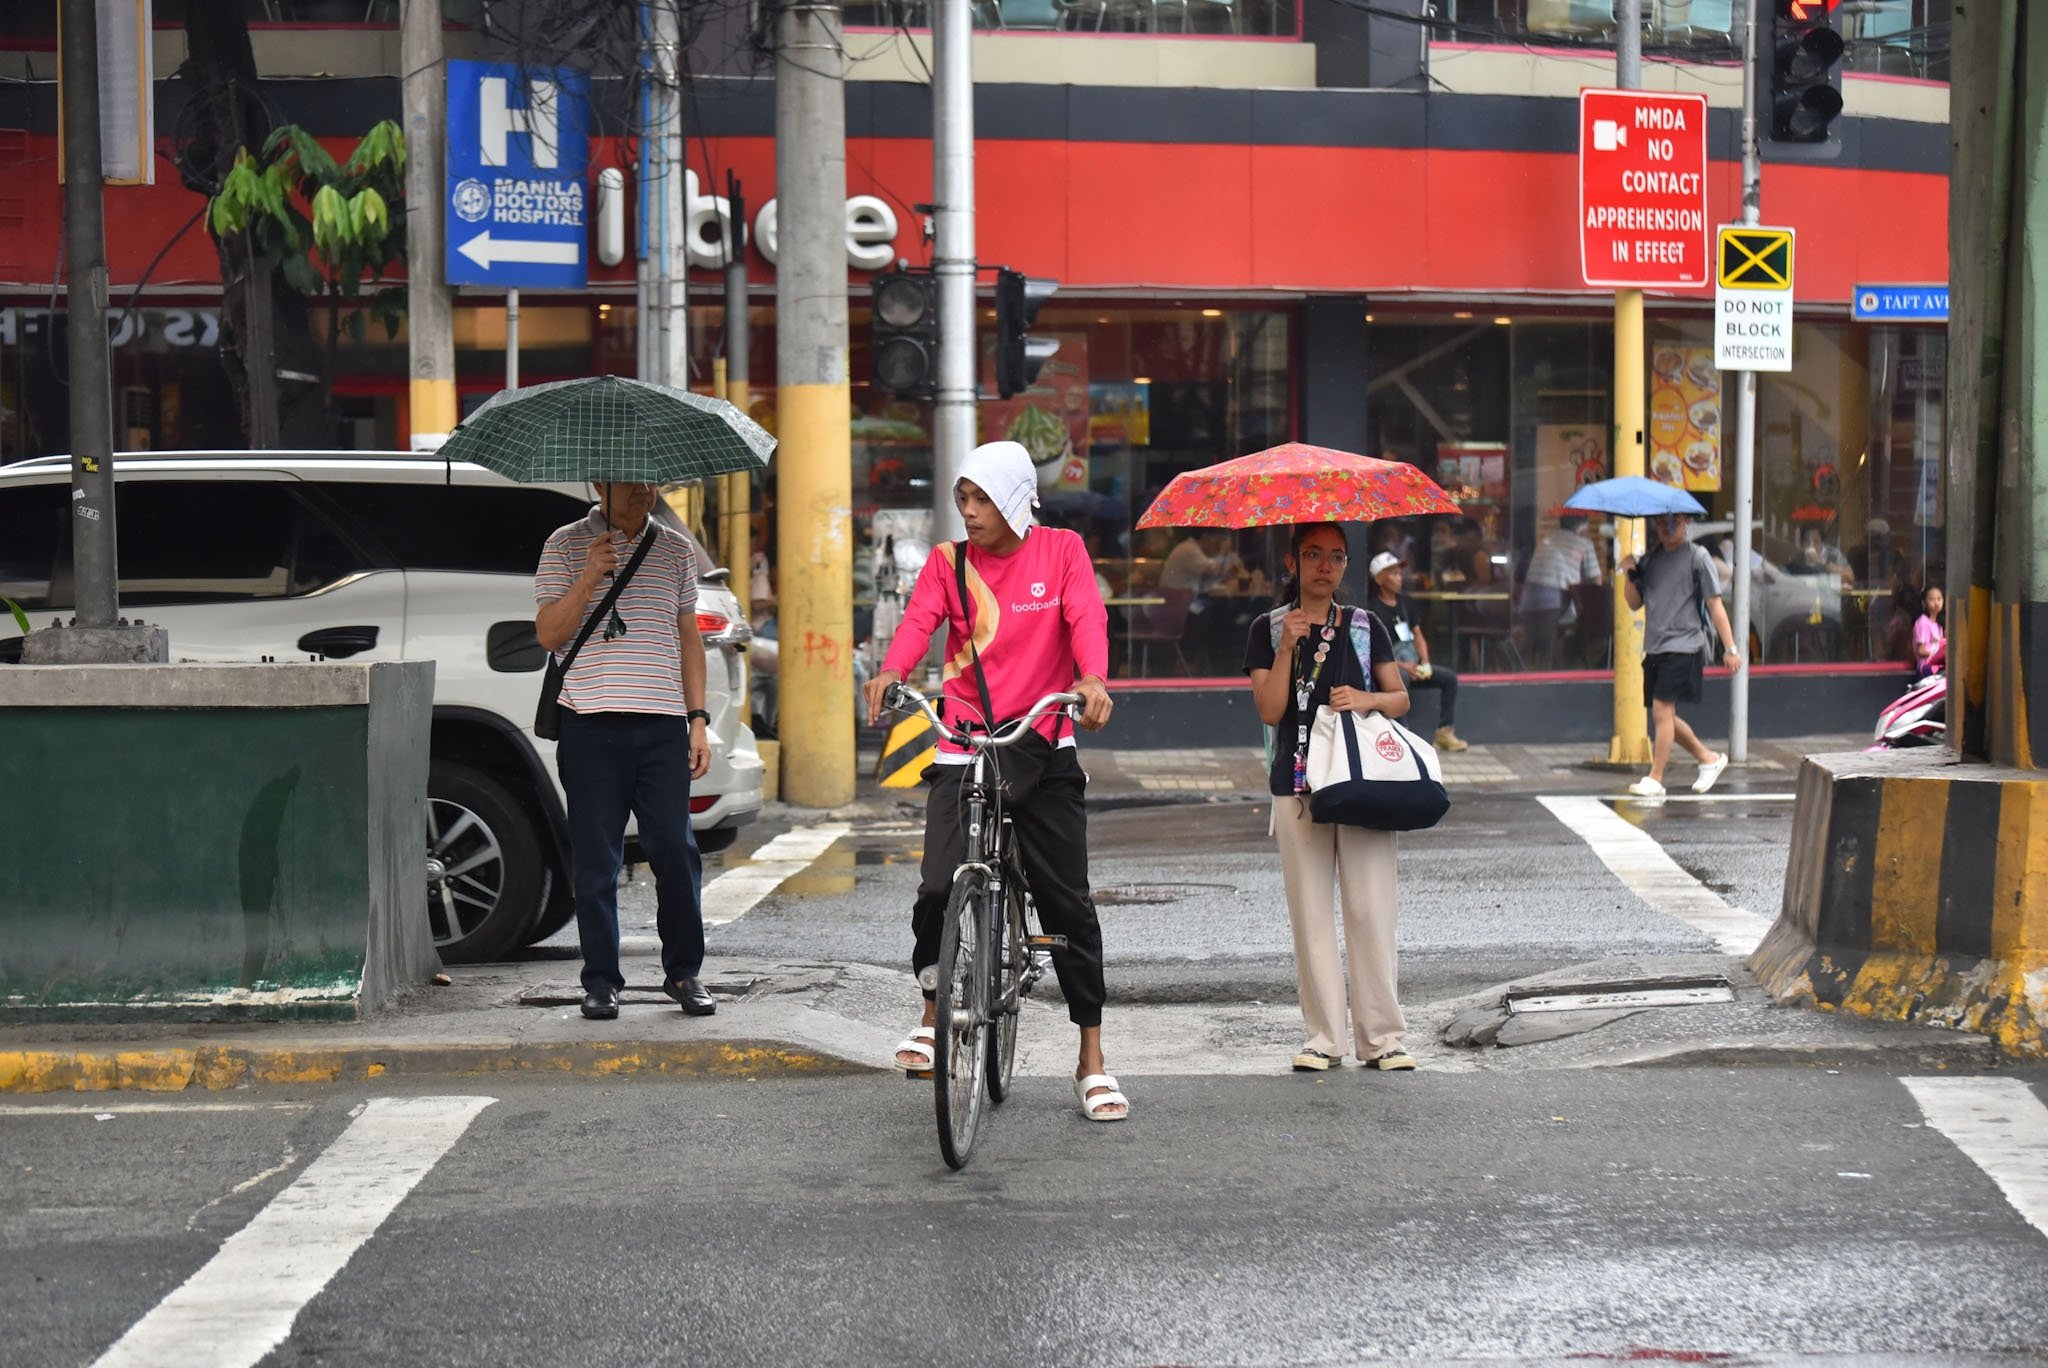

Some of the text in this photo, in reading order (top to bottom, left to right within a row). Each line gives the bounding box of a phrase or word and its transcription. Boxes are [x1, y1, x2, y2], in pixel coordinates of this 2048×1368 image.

[480, 76, 558, 169] H
[1635, 106, 1686, 131] MMDA
[1648, 138, 1674, 161] NO
[494, 178, 583, 197] MANILA
[1622, 170, 1700, 195] CONTACT
[494, 193, 583, 212] DOCTORS
[494, 208, 583, 226] HOSPITAL
[1586, 206, 1702, 231] APPREHENSION
[1612, 240, 1685, 264] IN EFFECT
[1724, 300, 1784, 315] DO NOT
[1883, 294, 1921, 310] TAFT
[1726, 322, 1781, 337] BLOCK
[1722, 345, 1785, 360] INTERSECTION
[1011, 596, 1061, 613] foodpand
